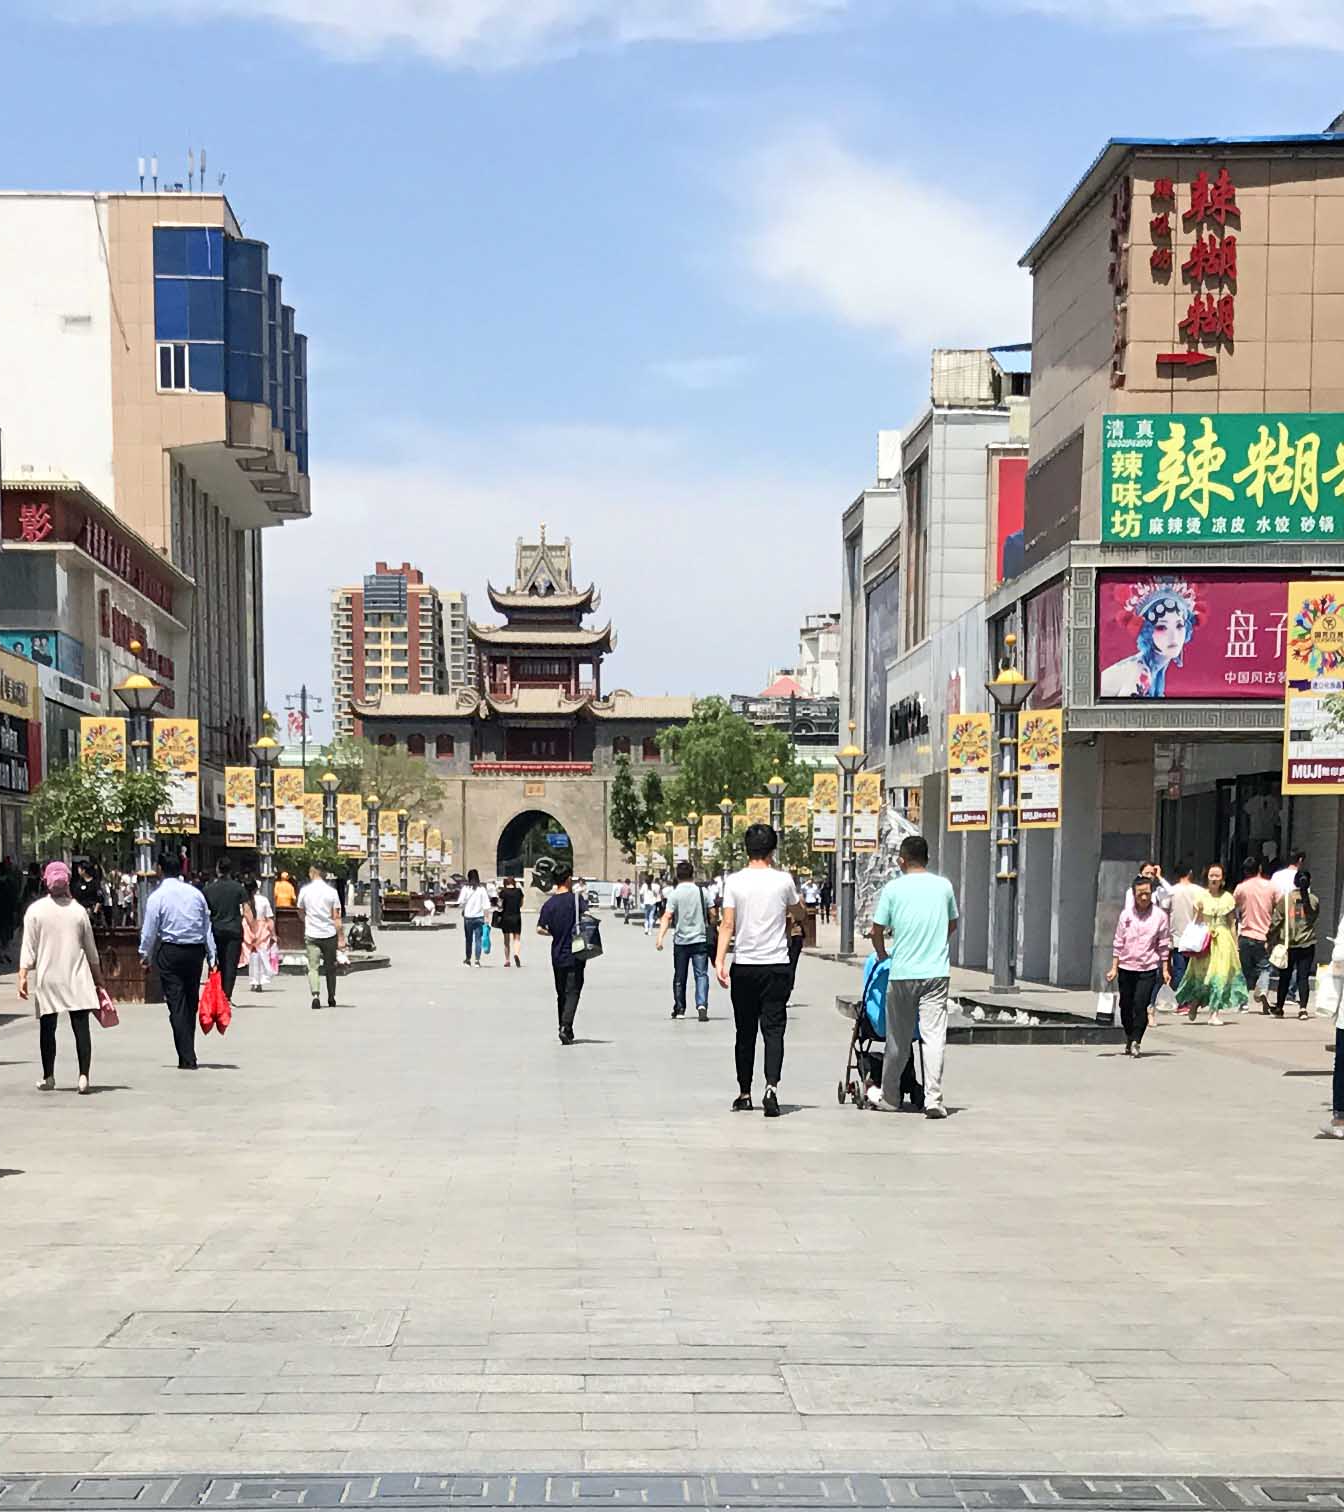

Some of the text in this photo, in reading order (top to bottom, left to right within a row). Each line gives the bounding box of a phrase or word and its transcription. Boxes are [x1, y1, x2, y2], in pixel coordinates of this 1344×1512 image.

[1177, 167, 1241, 341] 辣糊糊
[1110, 450, 1144, 538] 辣味坊
[18, 502, 54, 543] 影
[1148, 516, 1202, 535] 麻辣烫
[1255, 516, 1290, 533] 水饺
[1300, 516, 1335, 533] 砂锅
[1224, 609, 1288, 659] 盘子
